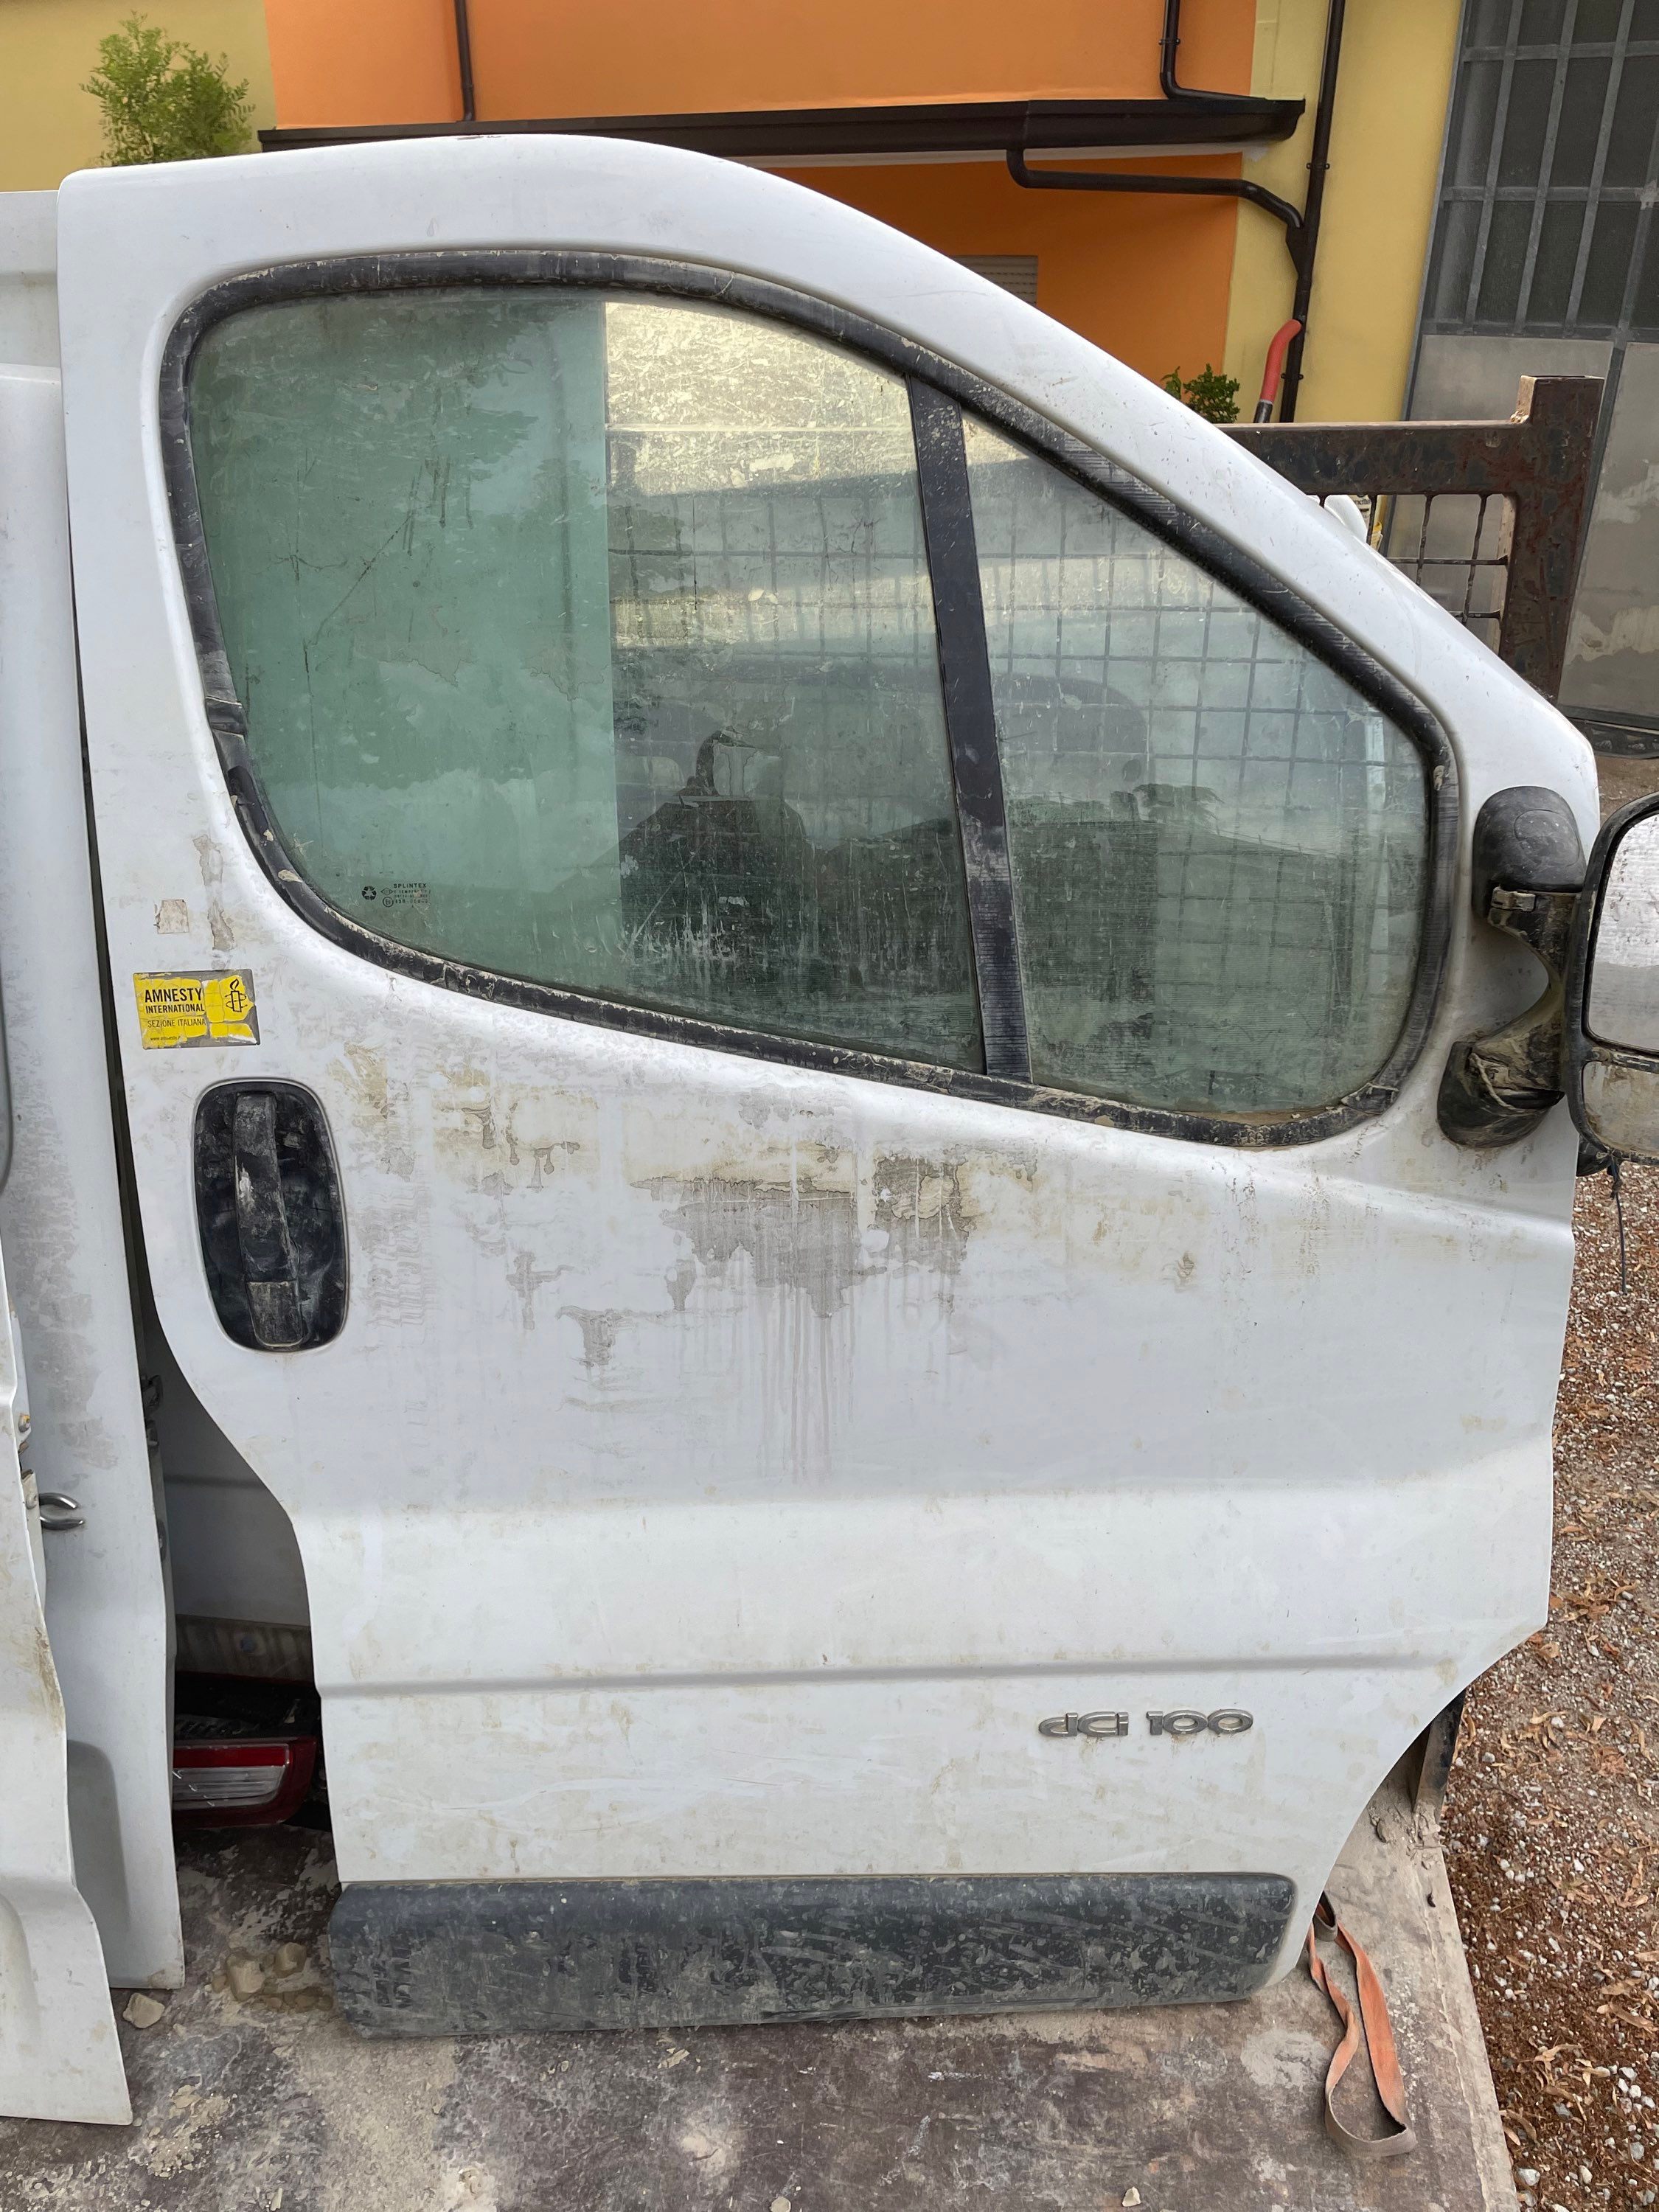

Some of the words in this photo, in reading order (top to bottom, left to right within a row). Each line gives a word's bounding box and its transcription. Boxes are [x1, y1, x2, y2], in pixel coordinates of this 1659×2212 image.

[145, 987, 202, 1003] AMNESTY
[145, 1004, 205, 1014] INTERNATIONAL
[147, 1019, 175, 1028] SEZIONE
[178, 1018, 206, 1026] ITALIANA
[1146, 1708, 1254, 1736] 100
